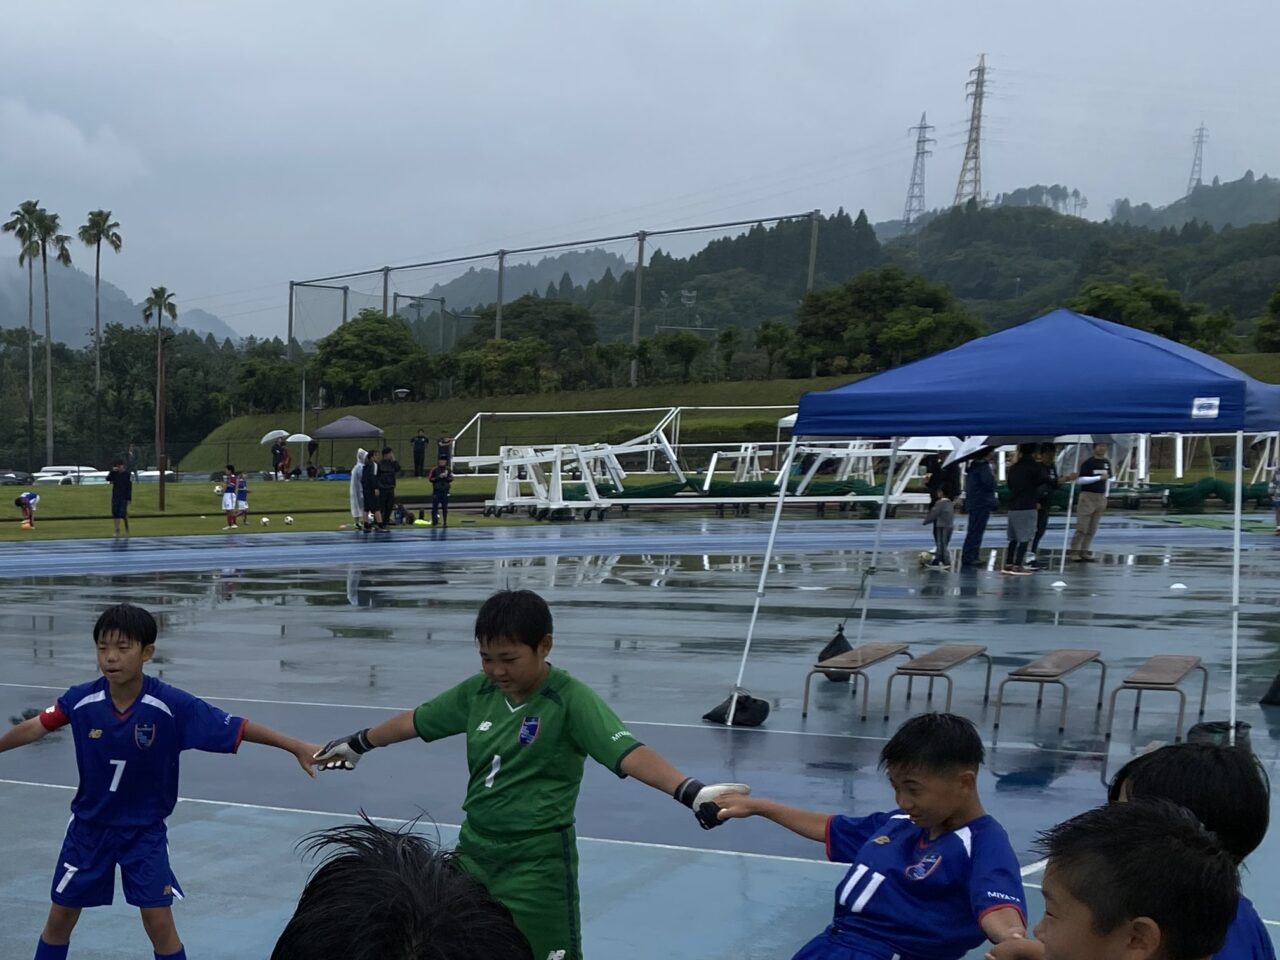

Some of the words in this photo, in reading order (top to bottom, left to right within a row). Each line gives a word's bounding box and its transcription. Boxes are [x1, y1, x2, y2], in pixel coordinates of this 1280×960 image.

[108, 759, 127, 792] 7
[485, 754, 502, 789] 1
[56, 861, 79, 894] 7
[838, 863, 887, 913] 11
